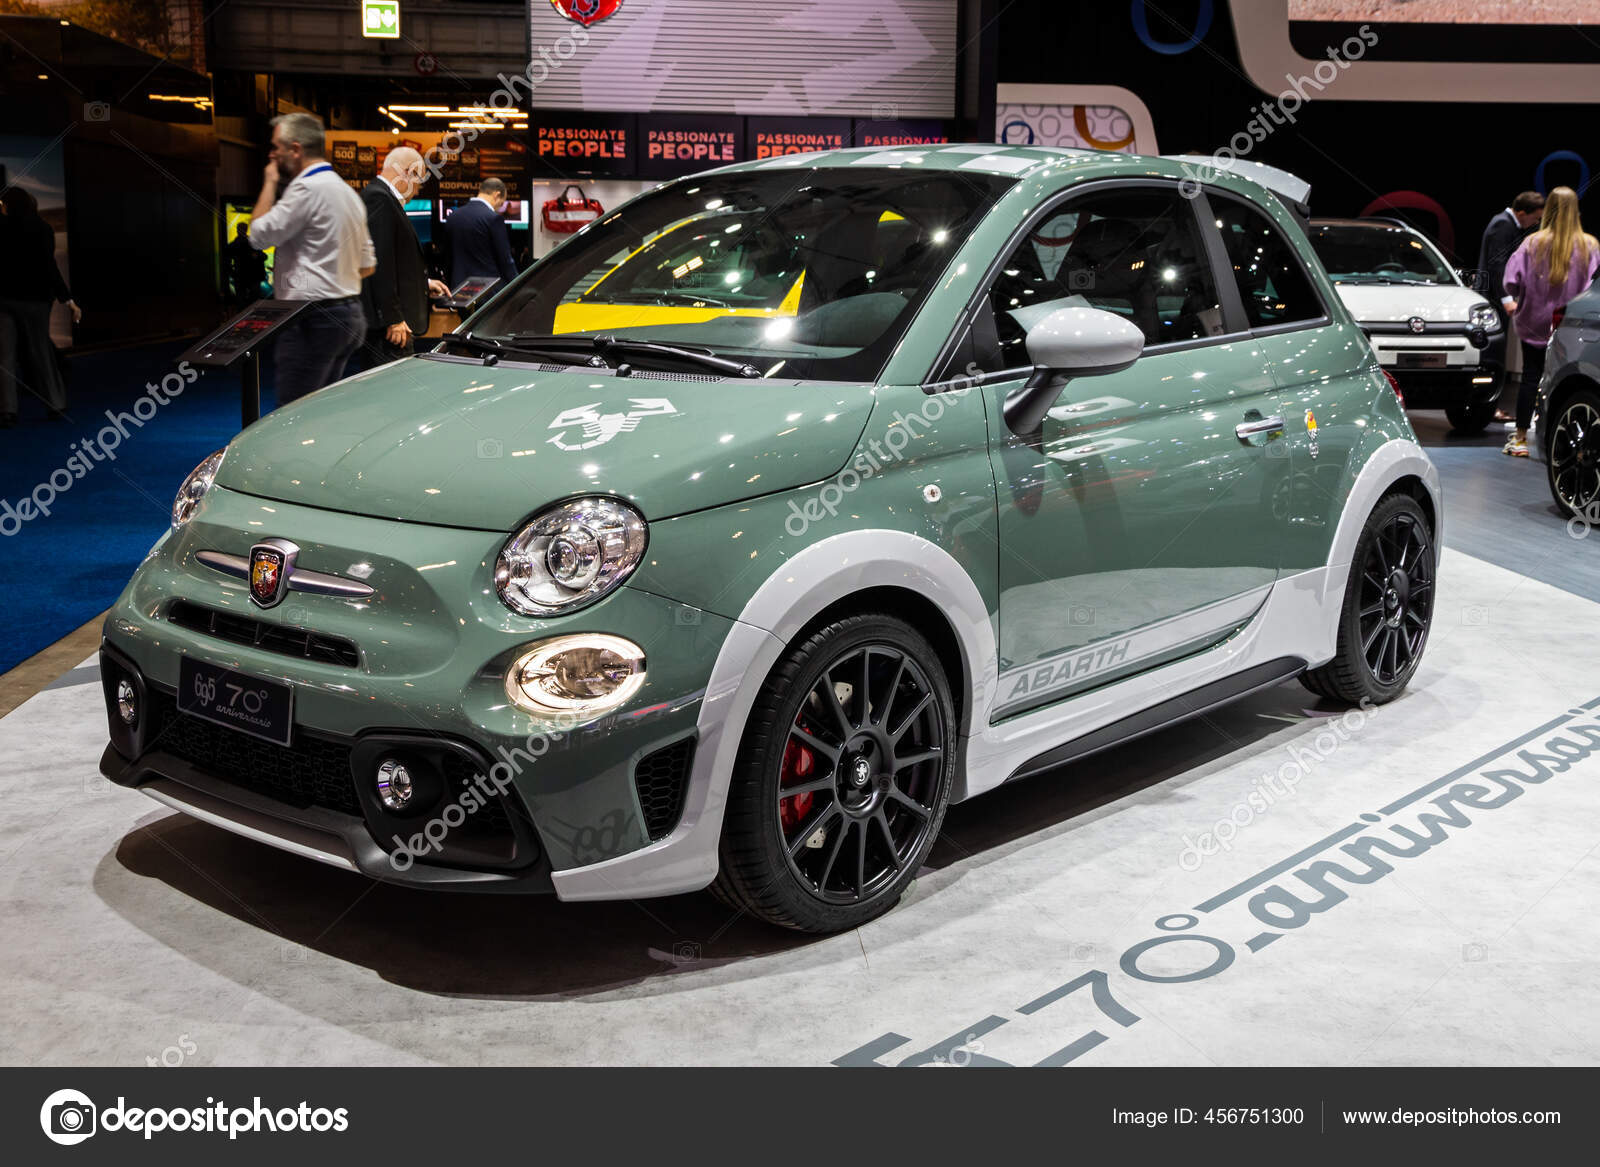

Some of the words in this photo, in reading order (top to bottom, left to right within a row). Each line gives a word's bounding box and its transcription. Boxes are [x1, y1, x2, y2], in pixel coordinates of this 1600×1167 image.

[538, 127, 626, 140] PASSIONATE
[648, 131, 735, 143] PASSIONATE
[756, 133, 842, 145] PASSIONATE
[538, 140, 626, 158] PEOPLE
[648, 143, 735, 160] PEOPLE
[1008, 640, 1131, 699] ABARTH
[1247, 709, 1600, 929] anniversar
